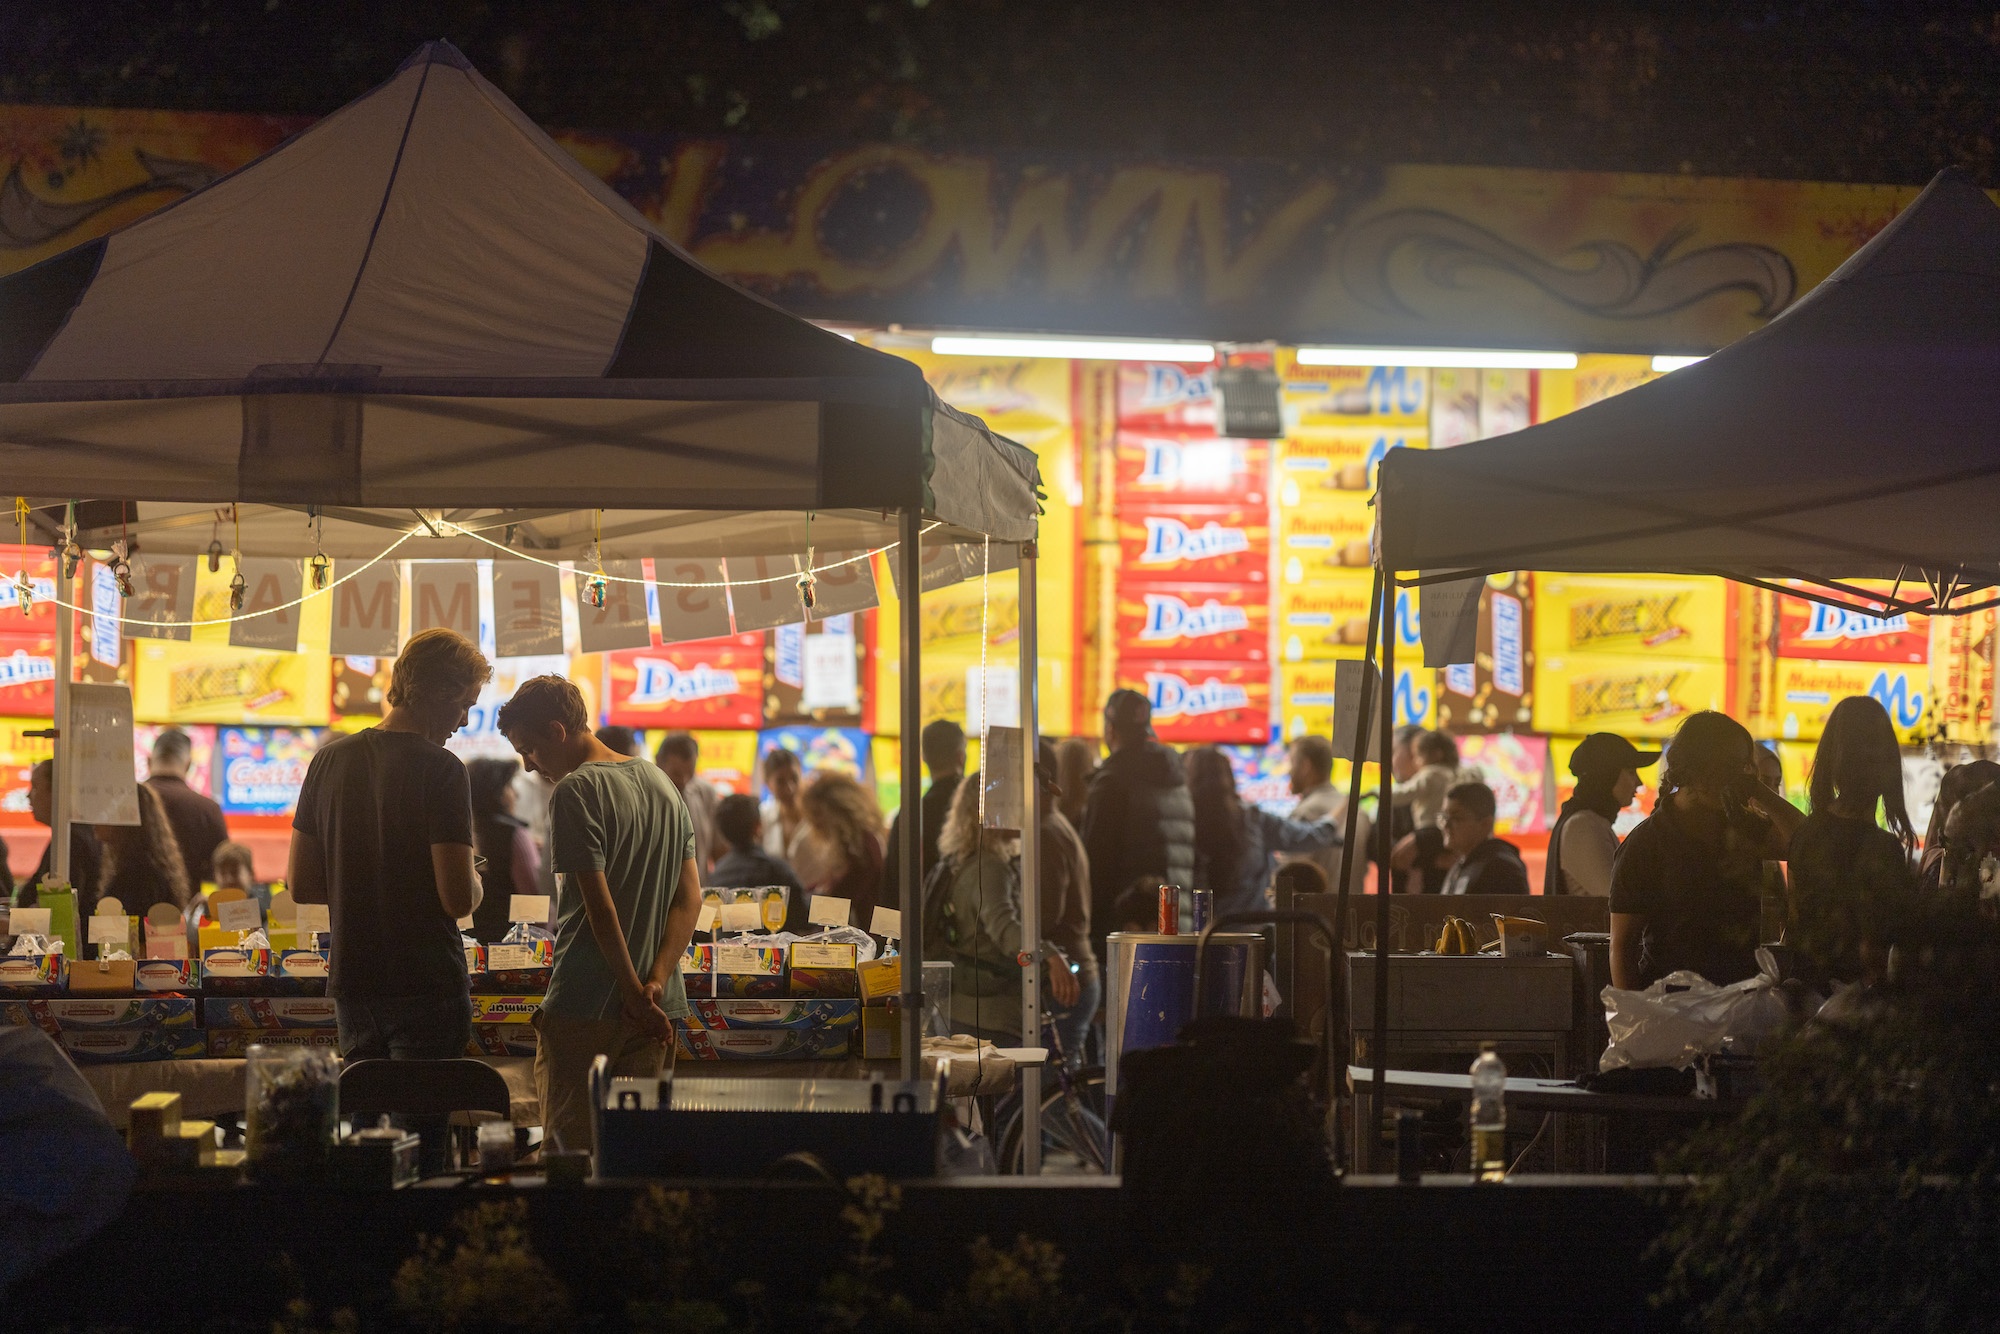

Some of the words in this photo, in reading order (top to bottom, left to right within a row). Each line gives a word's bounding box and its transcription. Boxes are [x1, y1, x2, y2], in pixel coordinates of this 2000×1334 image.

[560, 143, 1340, 306] LOWN
[1142, 517, 1248, 562] Daim
[1142, 595, 1248, 639] Daim
[1574, 596, 1680, 640] KEX
[1803, 601, 1910, 639] Daim
[631, 658, 738, 704] Daim
[1144, 672, 1248, 717] Daim
